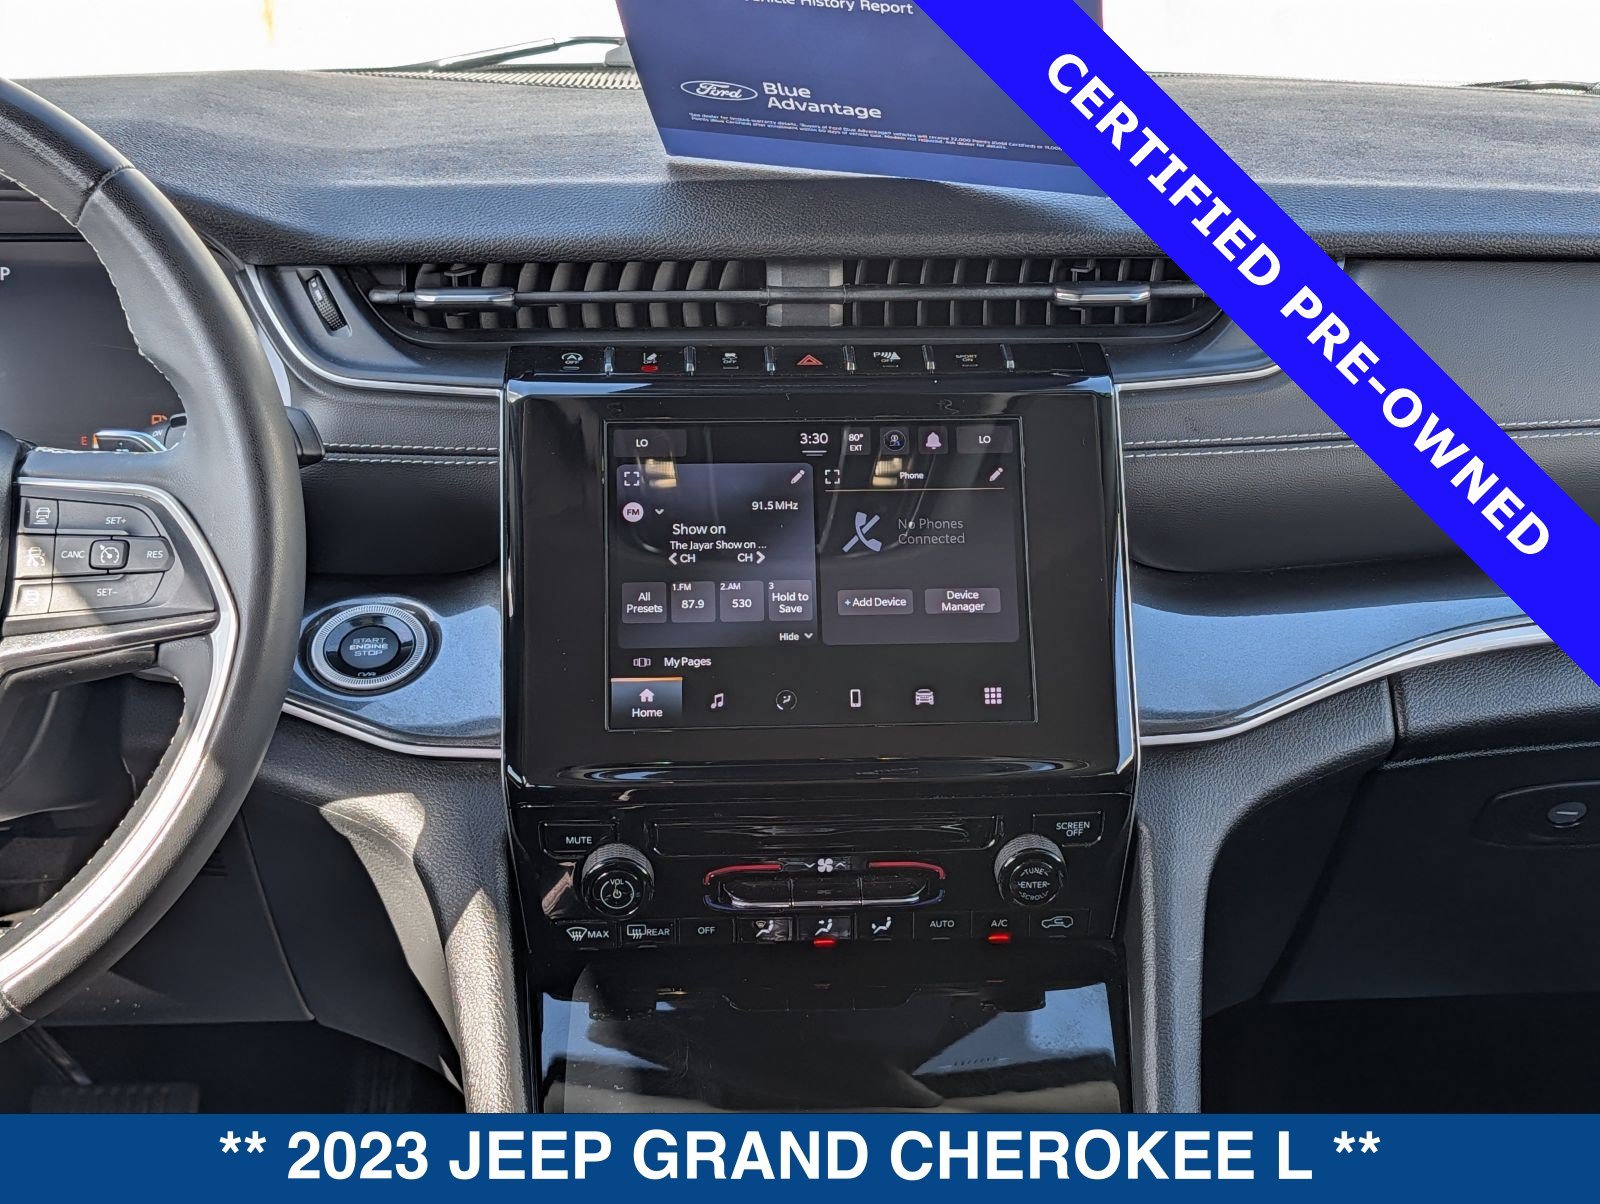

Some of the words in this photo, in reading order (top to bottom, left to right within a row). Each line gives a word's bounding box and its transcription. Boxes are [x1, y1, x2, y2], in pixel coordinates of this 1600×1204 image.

[860, 0, 914, 15] Report
[695, 81, 747, 100] Ford
[762, 81, 811, 99] Blue
[767, 97, 882, 120] Advantage
[635, 438, 649, 448] LO
[800, 432, 829, 445] 3:30
[978, 435, 992, 444] LO
[849, 444, 863, 452] EXT
[899, 471, 925, 480] Phone
[751, 500, 774, 511] 91.5
[775, 500, 799, 510] MHz
[626, 507, 640, 516] FM
[672, 523, 707, 535] Show
[709, 525, 727, 535] on
[898, 518, 916, 529] No
[919, 518, 964, 530] Phones
[898, 531, 966, 546] Connected
[669, 540, 689, 550] The
[689, 540, 714, 553] Jayar
[715, 540, 743, 550] Show
[743, 541, 757, 550] on
[60, 550, 86, 560] CANC
[146, 550, 164, 559] RES
[679, 553, 697, 564] CH
[737, 553, 754, 563] CH
[768, 581, 775, 590] 3
[637, 591, 651, 602] All
[771, 591, 796, 602] Hold
[797, 592, 809, 602] to
[946, 589, 980, 600] Device
[681, 599, 705, 609] 87.9
[732, 598, 753, 608] 530
[852, 597, 873, 607] Add
[874, 597, 907, 607] Device
[626, 603, 663, 614] Presets
[778, 604, 803, 614] Save
[941, 602, 986, 613] Manager
[352, 637, 386, 645] START
[779, 632, 800, 641] Hide
[349, 643, 389, 651] ENGINE
[663, 656, 680, 669] My
[681, 656, 712, 668] Pages
[631, 707, 663, 718] Home
[1055, 821, 1091, 831] SCREEN
[1065, 829, 1084, 837] OFF
[565, 836, 593, 845] MUTE
[1020, 881, 1048, 889] ENTER
[929, 919, 955, 928] AUTO
[990, 919, 1008, 928] A/C
[587, 930, 610, 939] MAX
[646, 928, 671, 937] REAR
[697, 926, 716, 935] OFF
